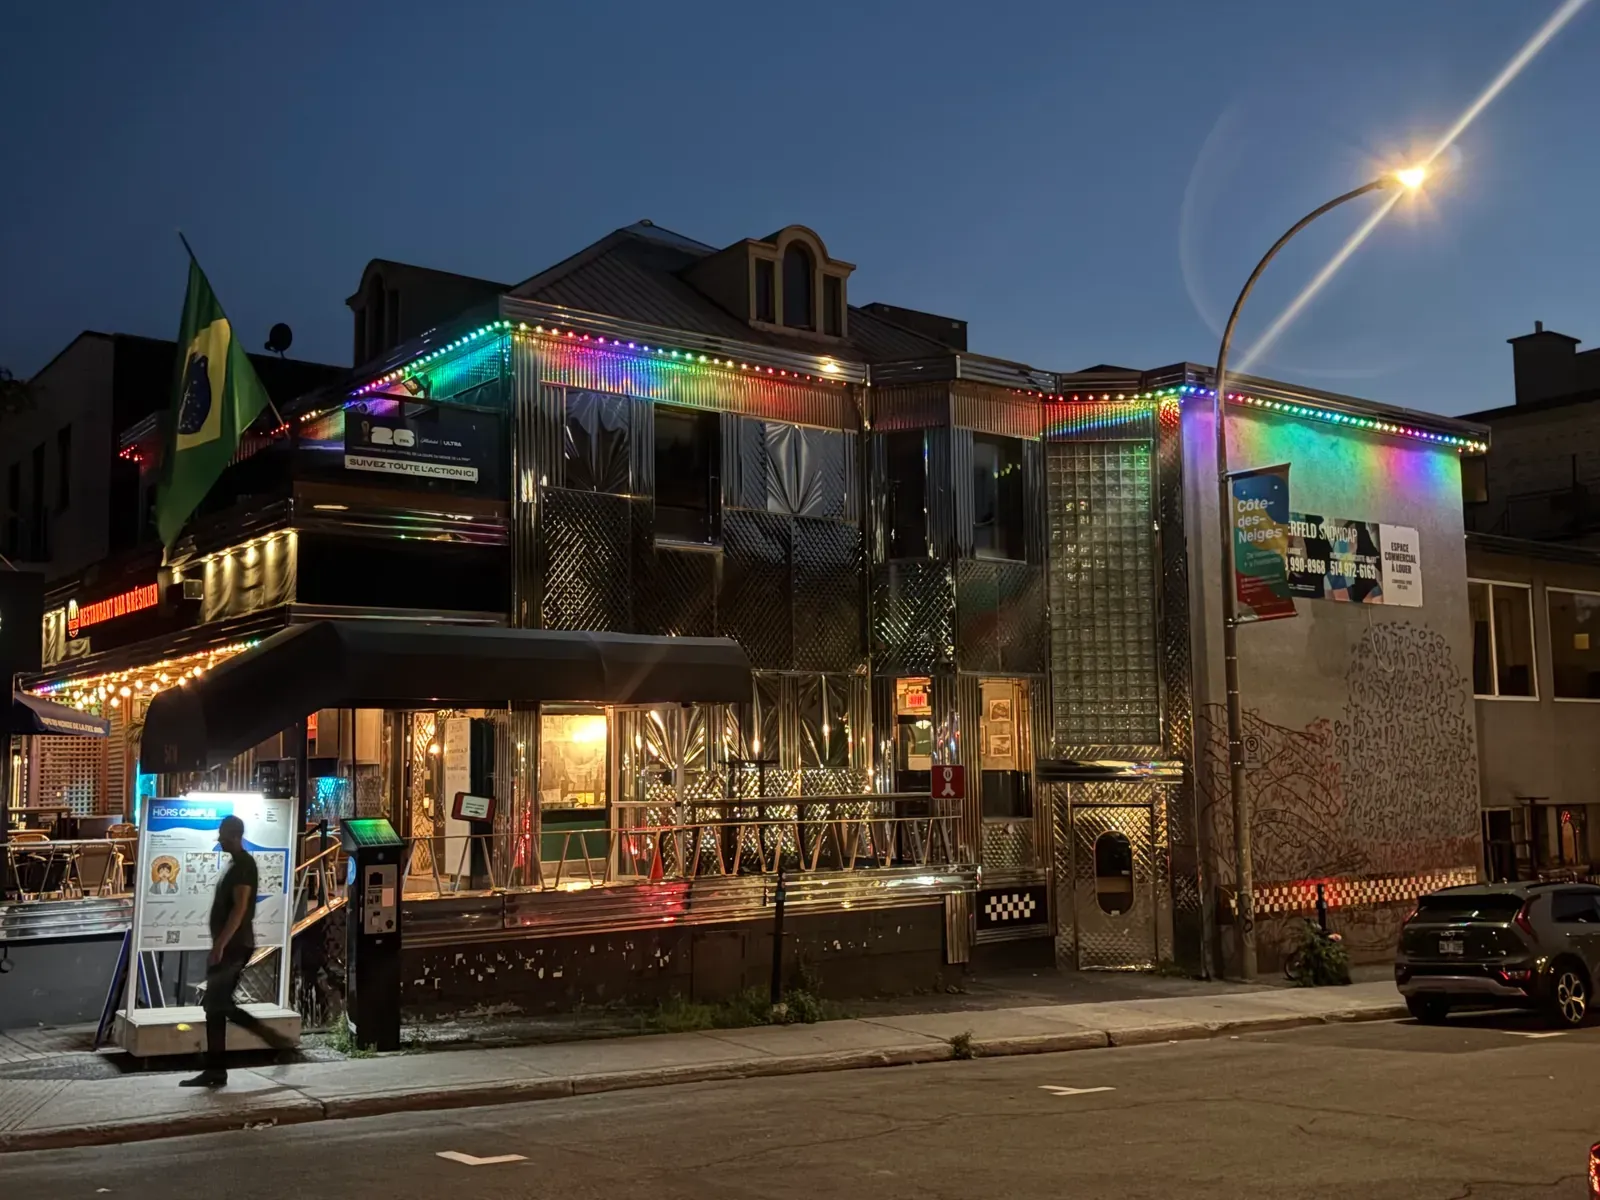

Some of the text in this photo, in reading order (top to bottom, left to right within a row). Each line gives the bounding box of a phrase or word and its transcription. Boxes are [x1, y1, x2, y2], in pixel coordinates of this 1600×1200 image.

[349, 458, 386, 468] SUIVEZ
[387, 462, 421, 472] TOUTE
[421, 465, 463, 476] L'ACTION
[1237, 498, 1275, 513] Côte-
[1238, 514, 1267, 529] des-
[1238, 527, 1283, 545] Neiges
[1391, 541, 1409, 553] ESPACE
[1384, 551, 1417, 564] COMMERCIAL
[1289, 557, 1326, 575] 990-8968
[1329, 560, 1343, 576] 514
[1343, 562, 1376, 580] 972-6163
[1395, 563, 1412, 574] LOUER
[79, 598, 113, 628] RESTAURANT
[113, 594, 126, 617] BAR
[125, 582, 158, 614] BRÉSILIEN
[153, 808, 179, 817] HORS
